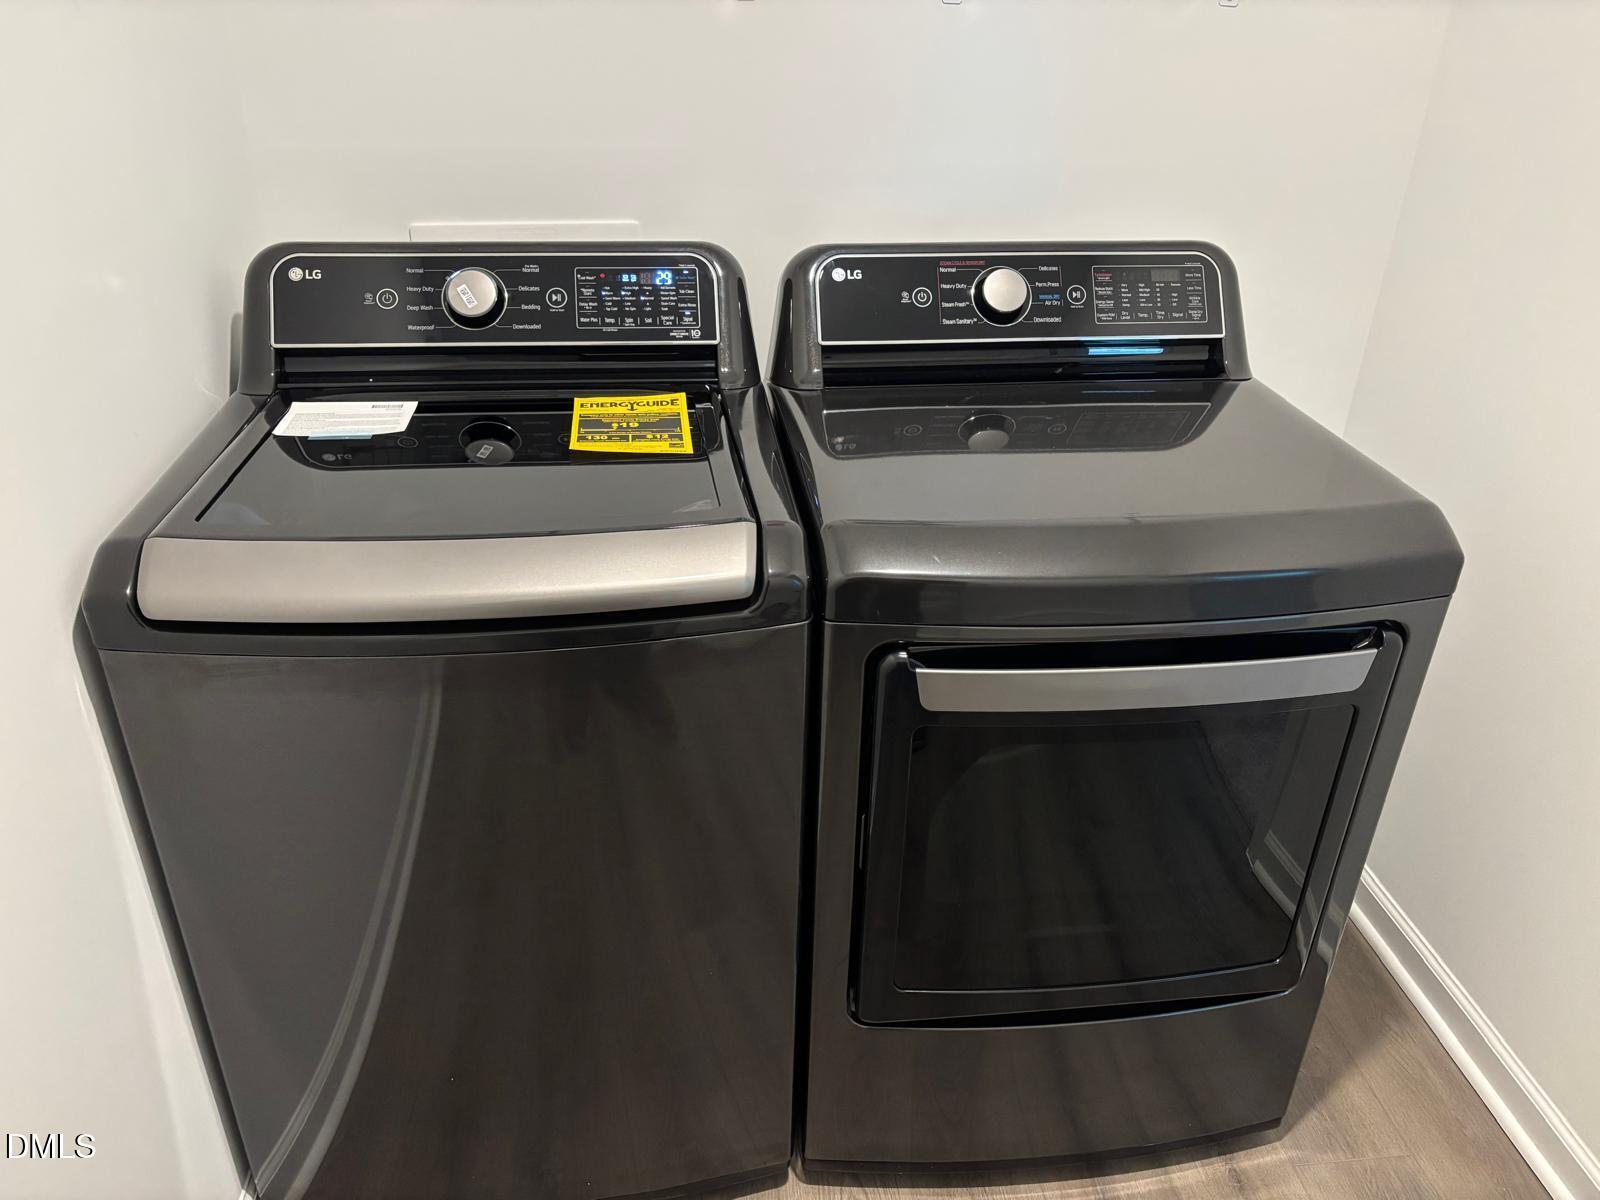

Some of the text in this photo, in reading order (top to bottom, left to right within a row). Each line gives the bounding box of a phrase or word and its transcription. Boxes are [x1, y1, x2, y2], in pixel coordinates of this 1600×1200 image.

[305, 269, 322, 280] LG
[846, 269, 863, 280] LG
[580, 398, 680, 411] ENERGYGUIDE
